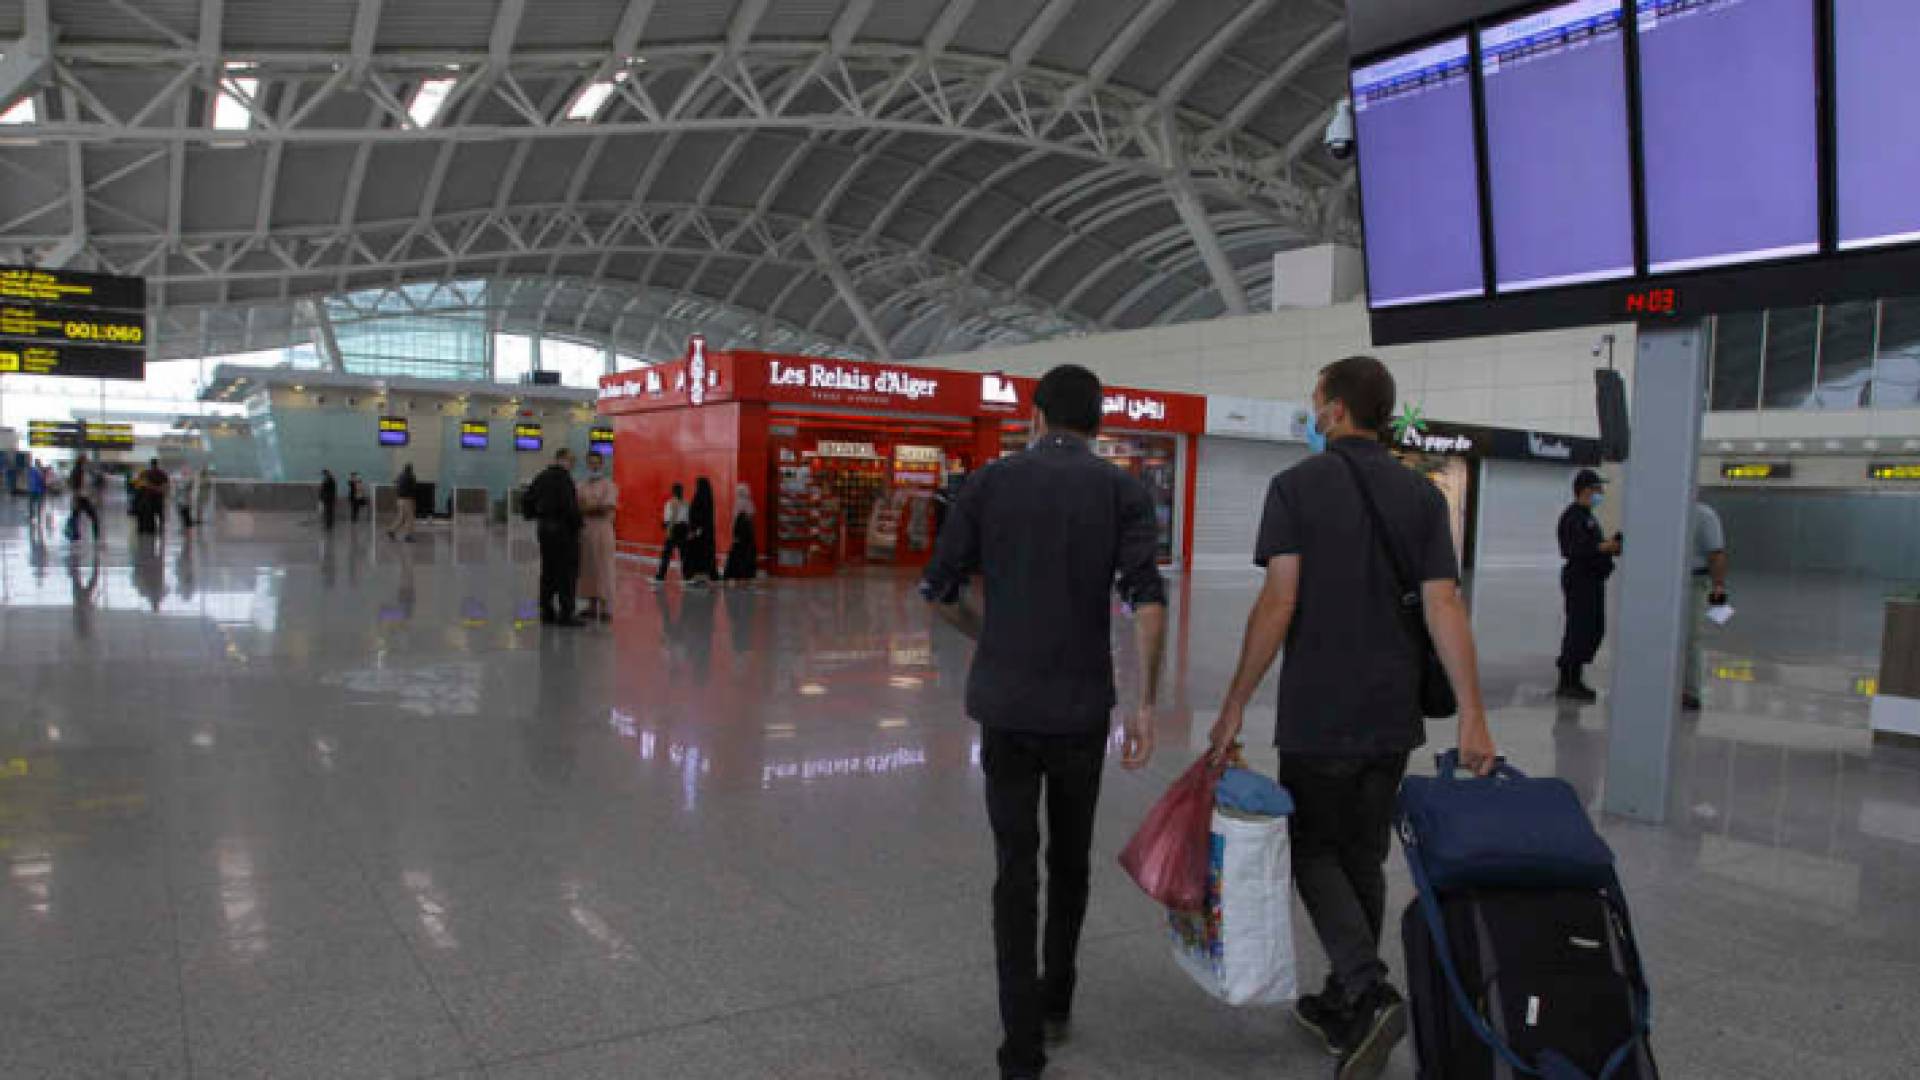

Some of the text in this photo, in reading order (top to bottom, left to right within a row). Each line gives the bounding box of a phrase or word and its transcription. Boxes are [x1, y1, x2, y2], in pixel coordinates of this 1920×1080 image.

[769, 361, 806, 385] Les
[809, 363, 871, 391] Relais
[874, 370, 938, 400] d'Alger
